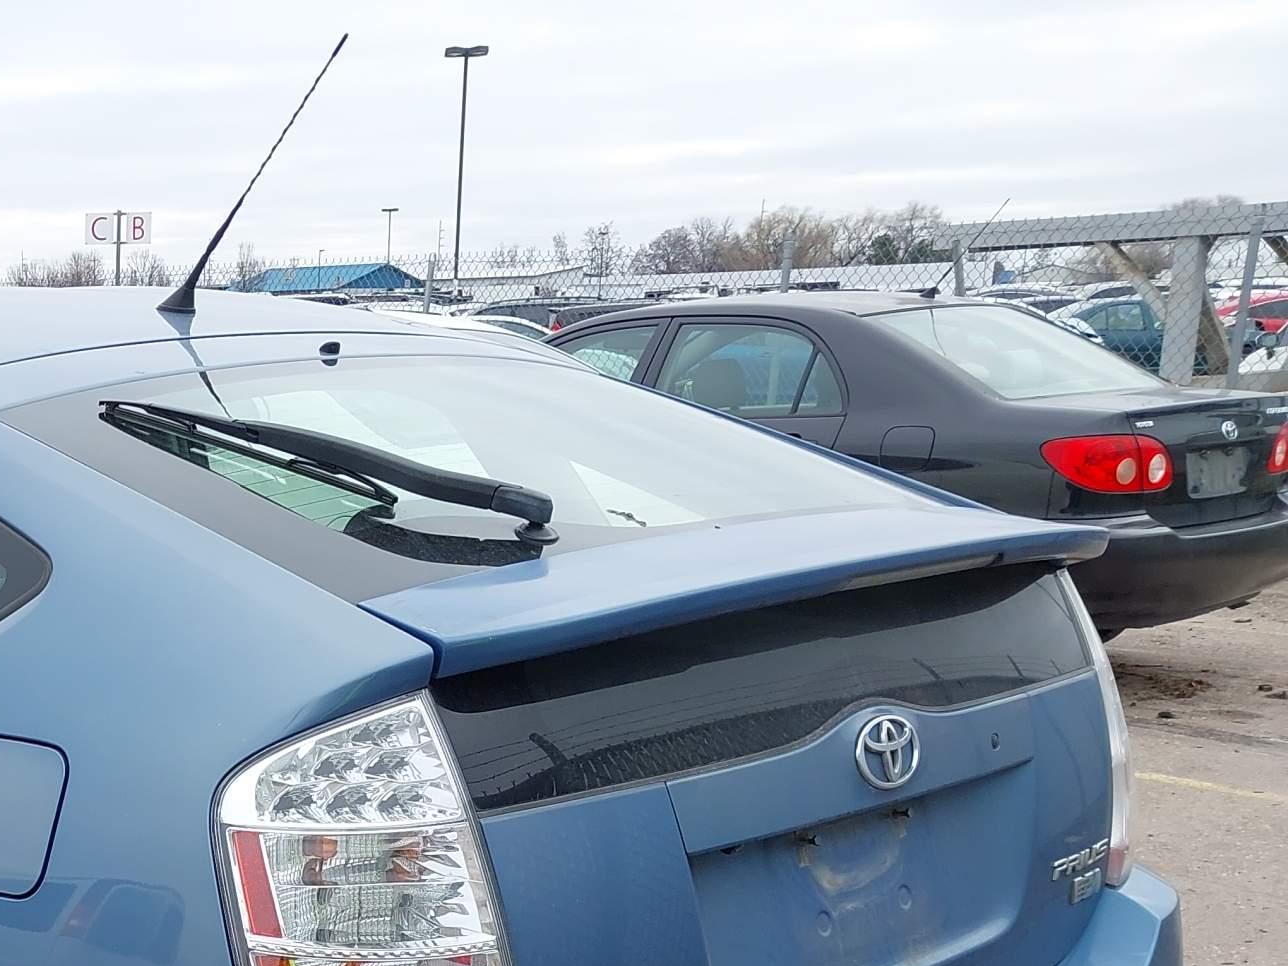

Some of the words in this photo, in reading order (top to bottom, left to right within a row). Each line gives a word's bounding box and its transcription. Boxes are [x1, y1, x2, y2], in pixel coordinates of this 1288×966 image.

[91, 216, 108, 241] C
[132, 216, 145, 241] B
[1051, 837, 1110, 881] PRIUS
